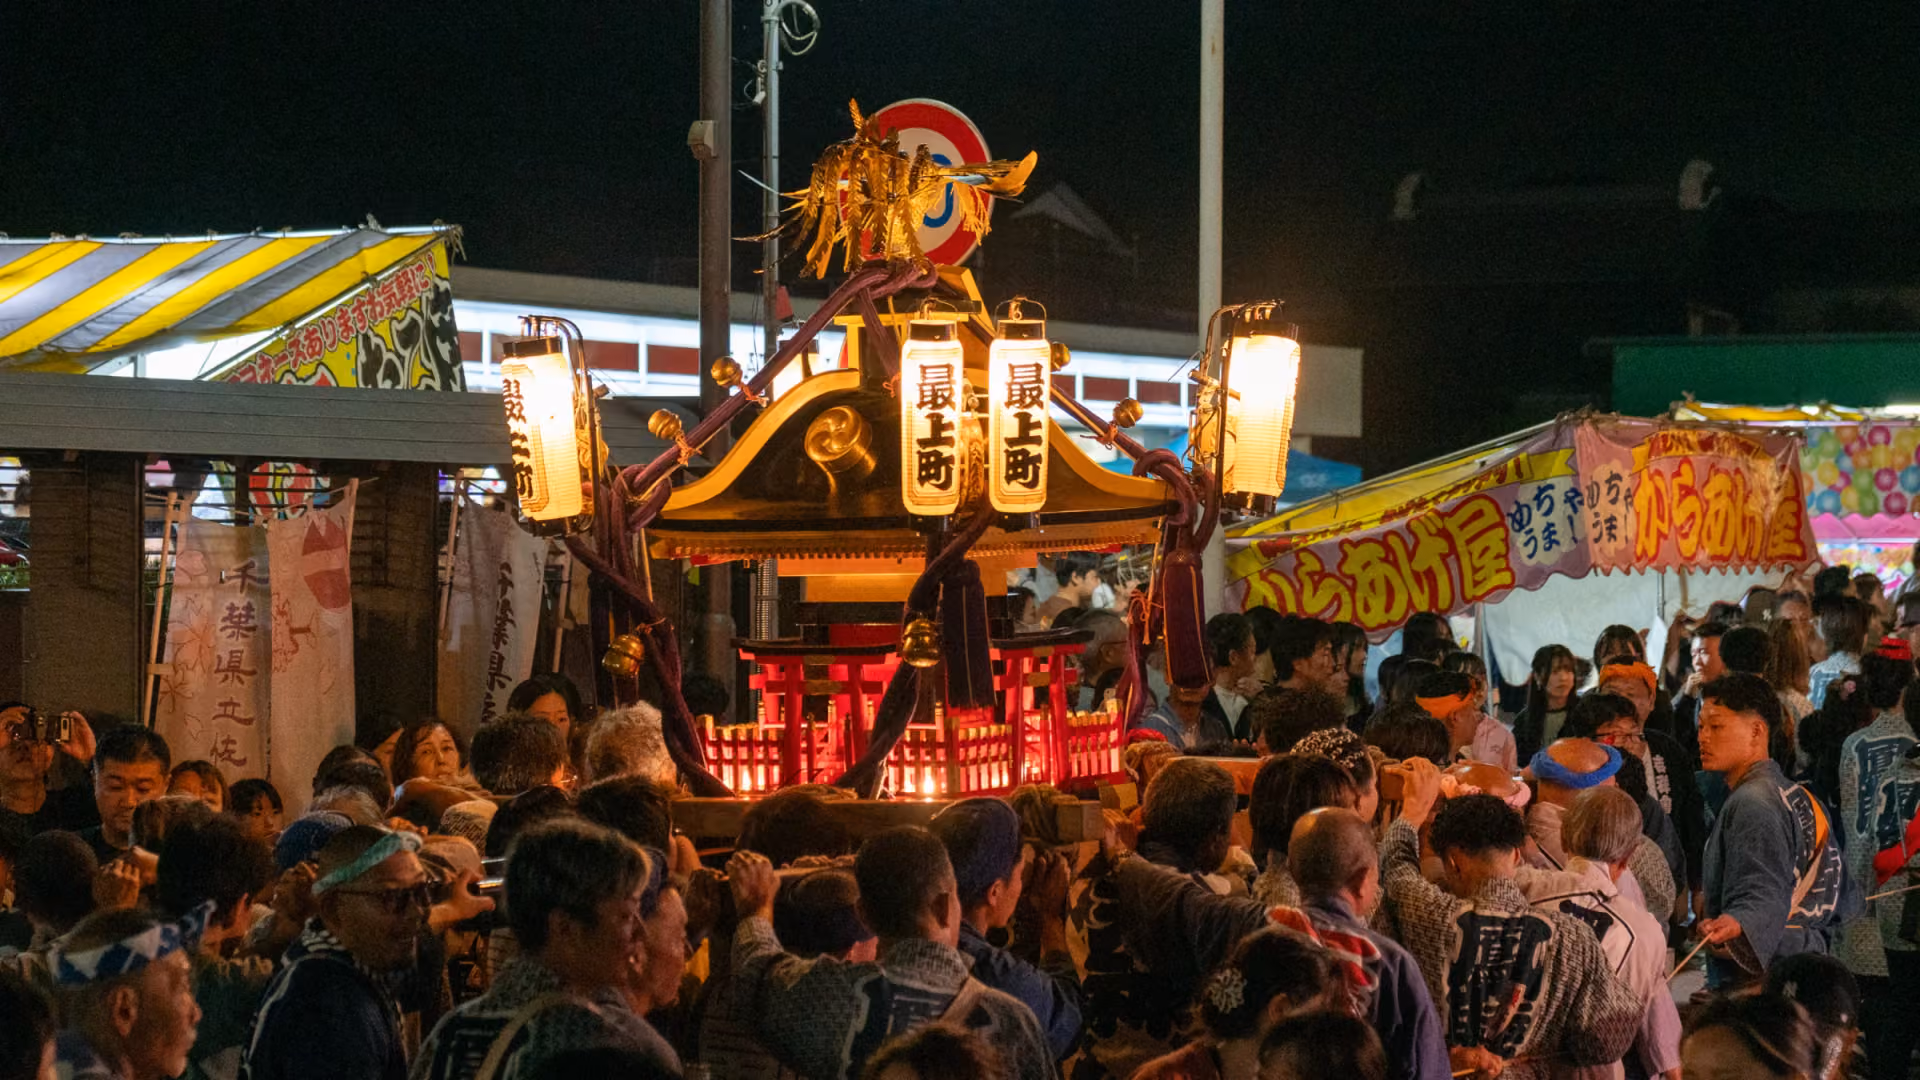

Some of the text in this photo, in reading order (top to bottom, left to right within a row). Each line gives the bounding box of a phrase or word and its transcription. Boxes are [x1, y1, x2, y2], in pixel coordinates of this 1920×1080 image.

[916, 362, 956, 490] 最上町
[1004, 362, 1046, 490] 最上町
[1242, 493, 1516, 630] からあげ屋
